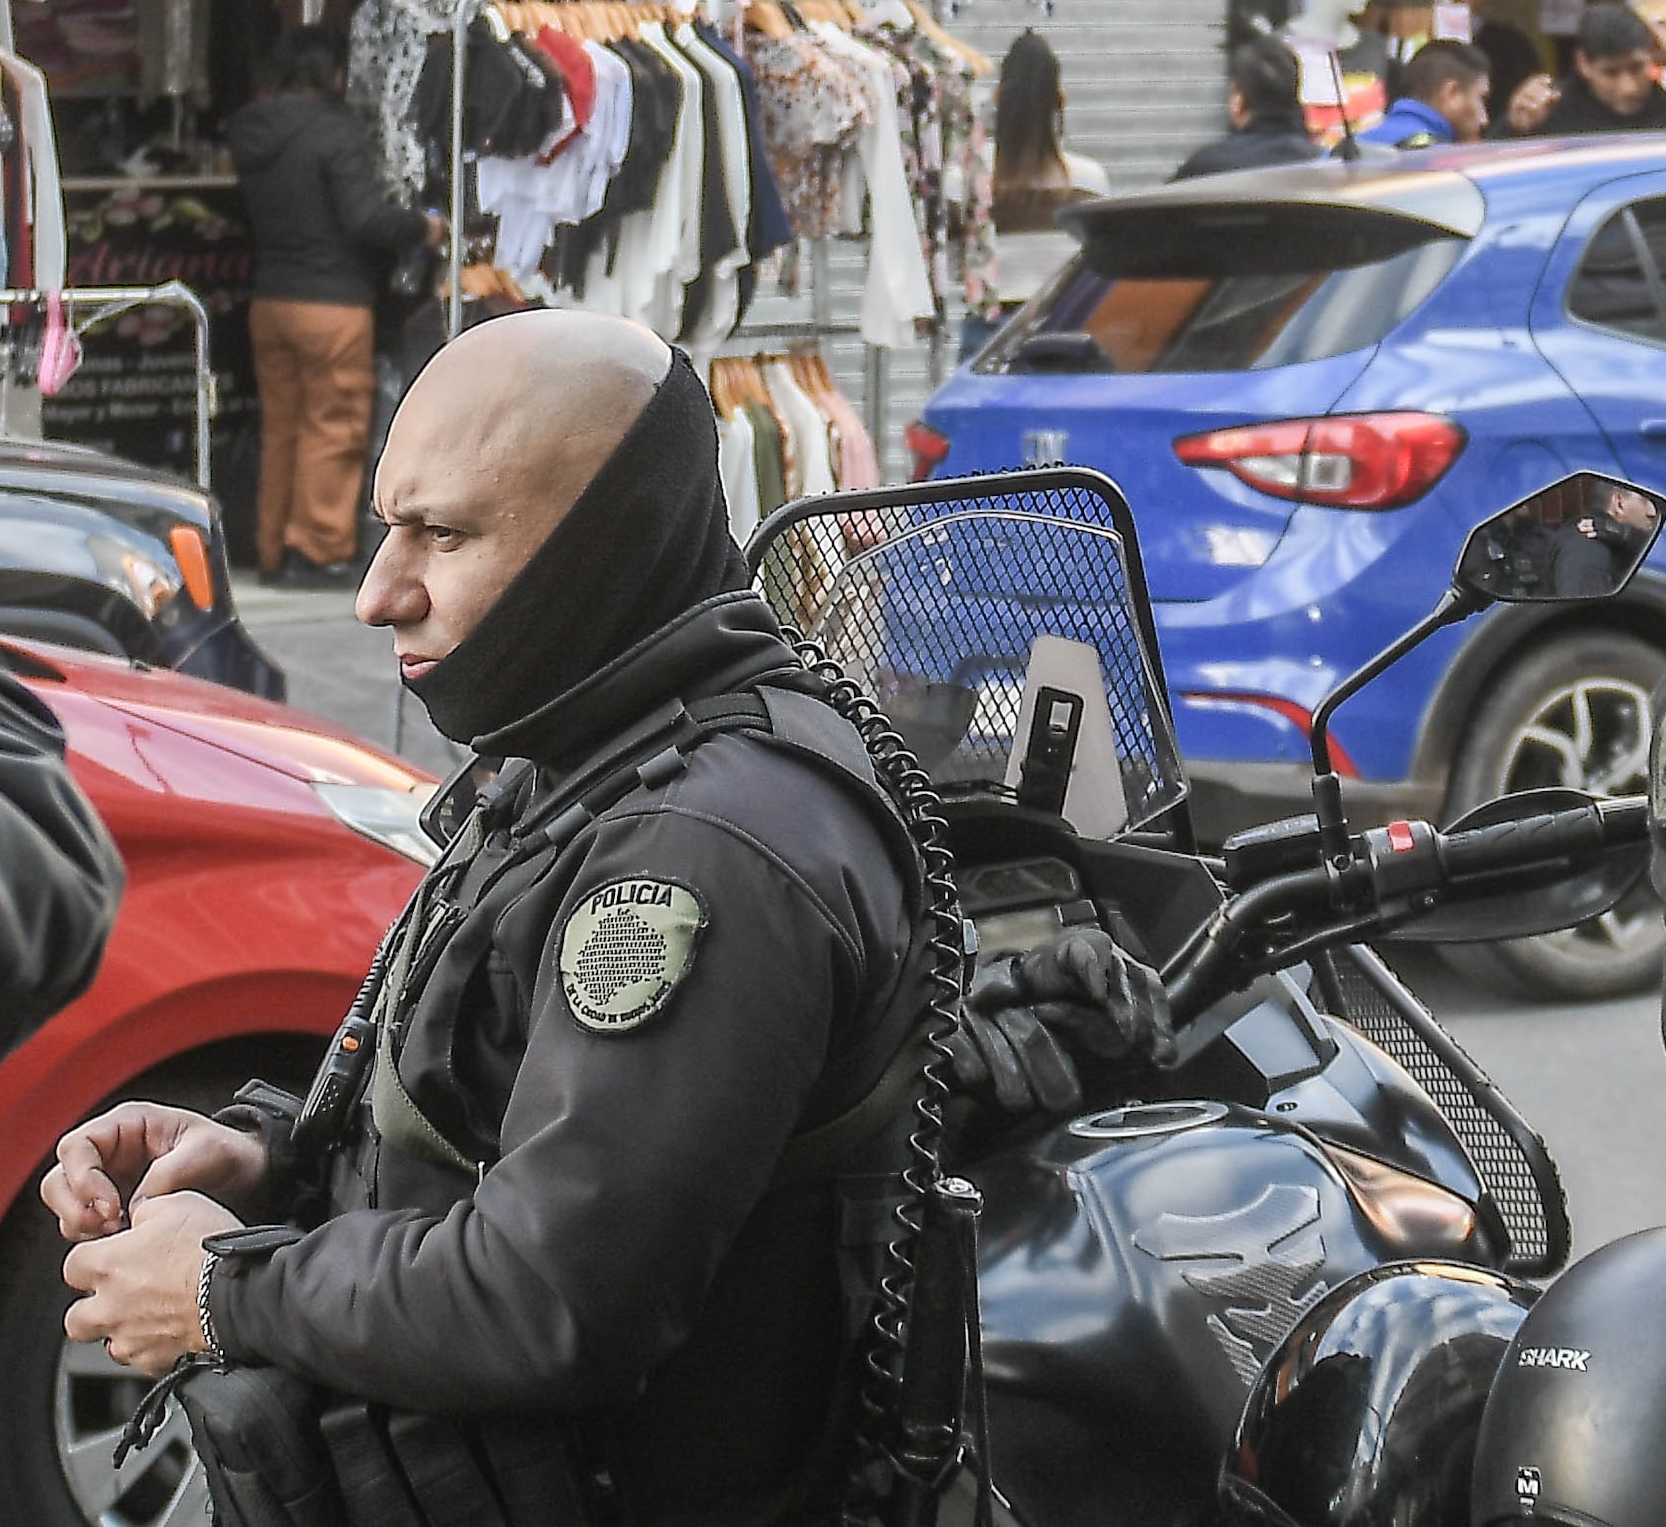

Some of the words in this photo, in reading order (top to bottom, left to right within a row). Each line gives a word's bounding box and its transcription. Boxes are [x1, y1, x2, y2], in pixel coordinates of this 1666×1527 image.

[590, 884, 673, 914] POLICIA
[1518, 1347, 1592, 1372] SHARK
[1517, 1479, 1539, 1495] M
